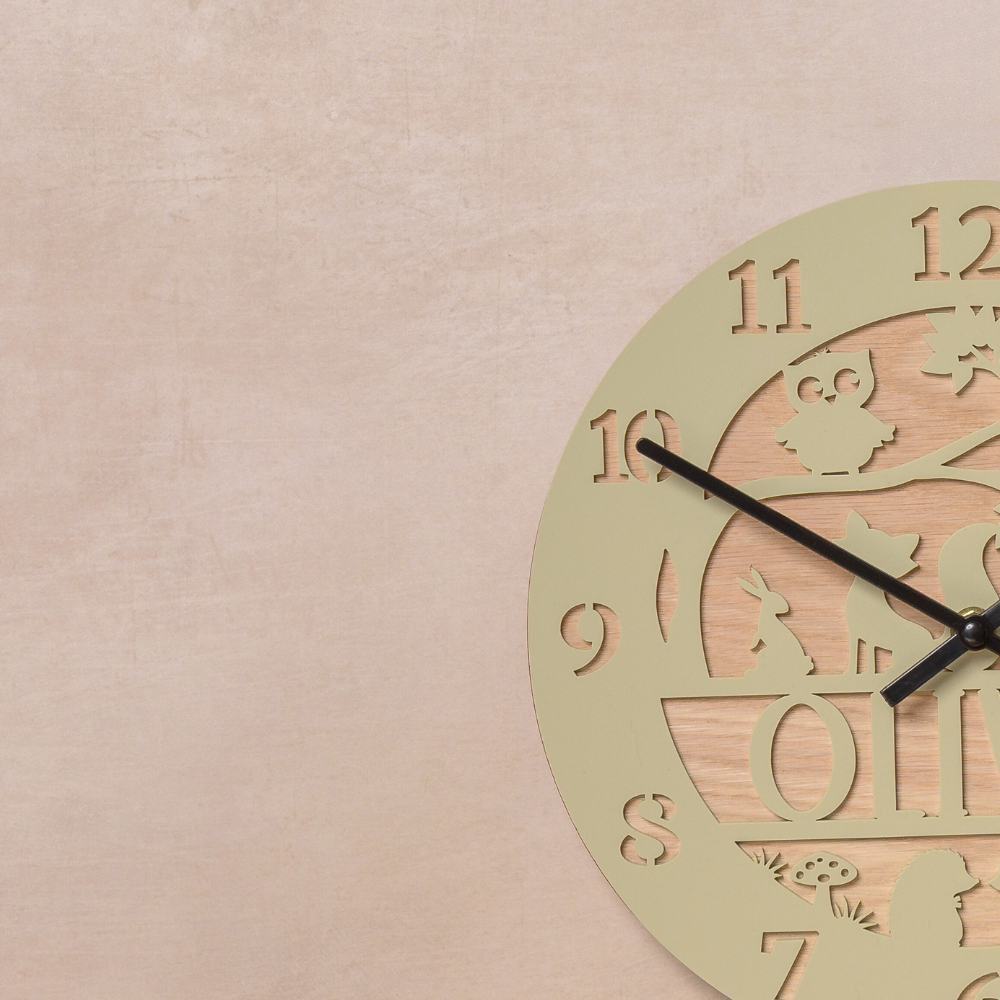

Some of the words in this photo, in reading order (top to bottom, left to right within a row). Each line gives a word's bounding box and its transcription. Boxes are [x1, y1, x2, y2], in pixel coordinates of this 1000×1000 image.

[728, 258, 812, 334] 11
[589, 408, 682, 484] 10
[560, 602, 621, 677] 9
[619, 793, 681, 867] 8
